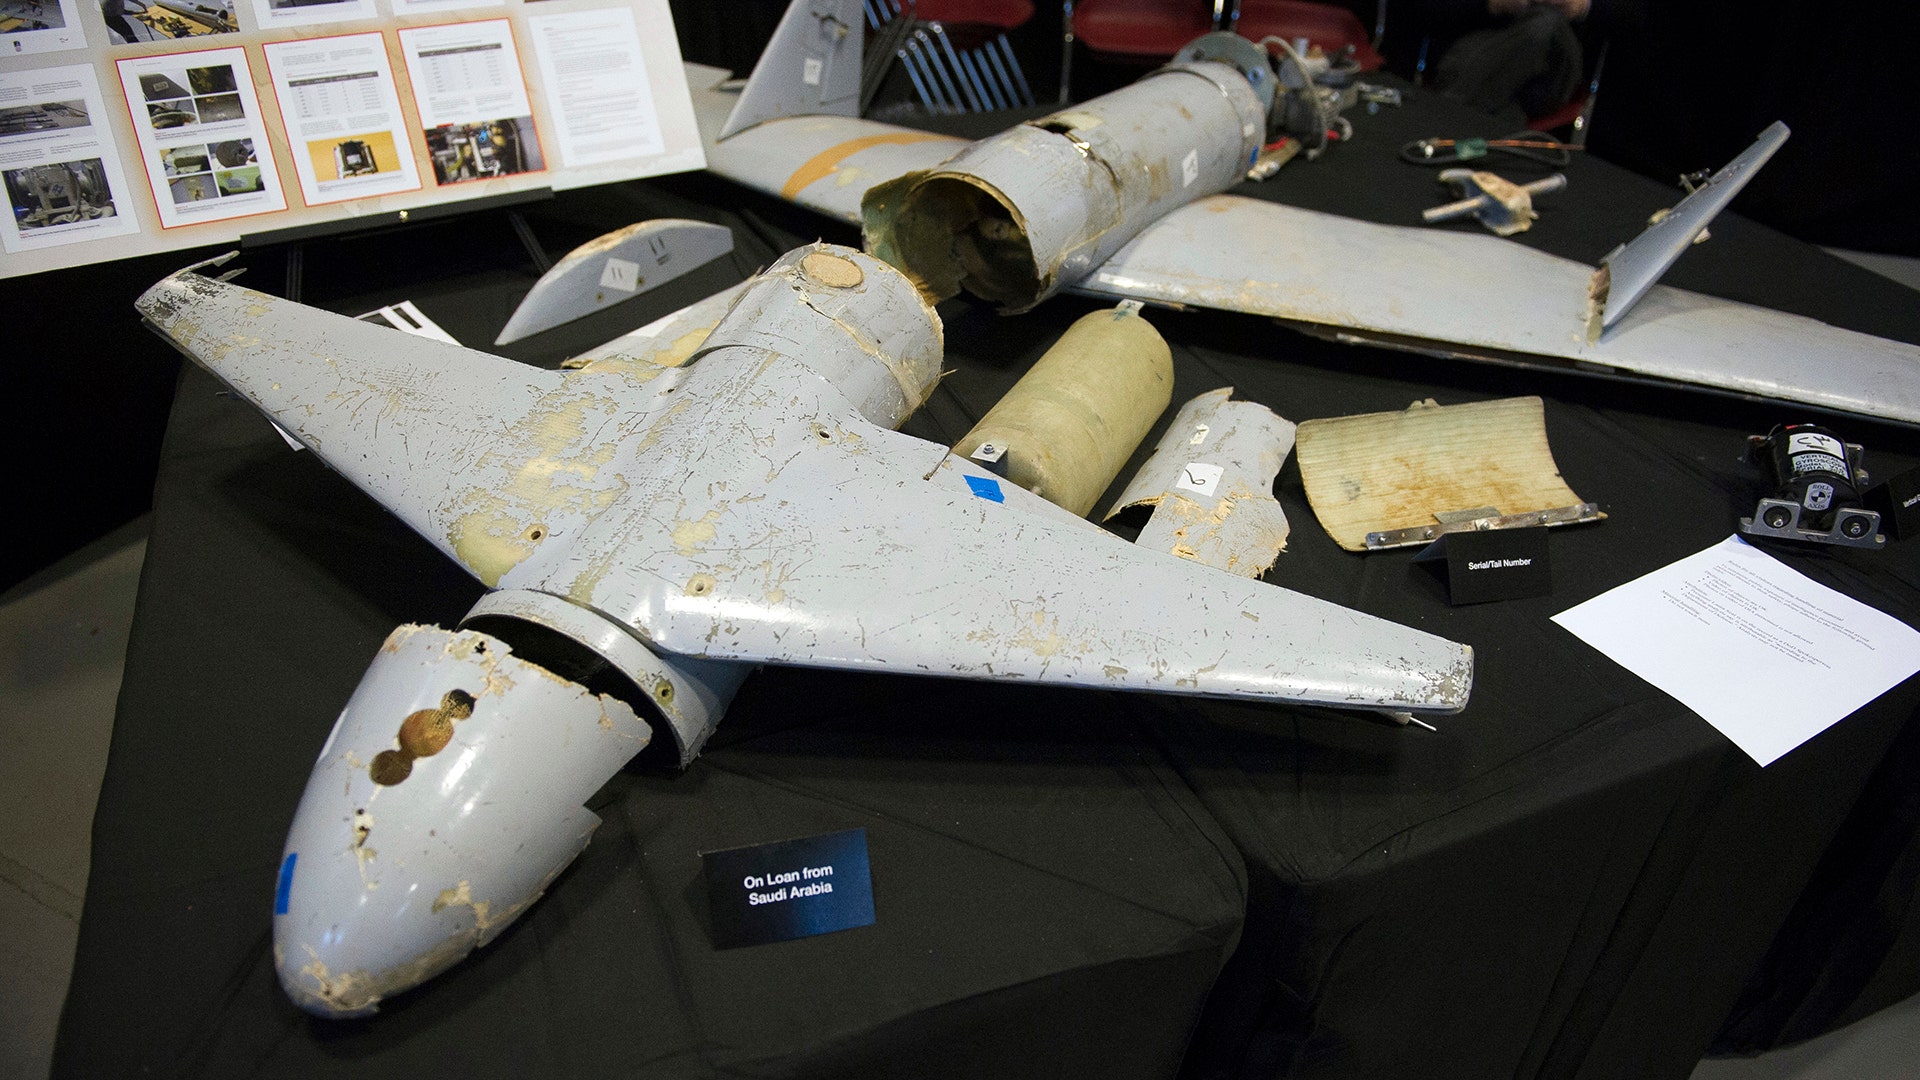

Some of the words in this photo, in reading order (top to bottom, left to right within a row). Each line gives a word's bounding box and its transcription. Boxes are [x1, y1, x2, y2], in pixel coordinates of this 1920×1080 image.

[1468, 560, 1502, 570] Serial/Tail
[1503, 558, 1532, 567] Number
[744, 876, 764, 889] On
[767, 870, 800, 886] Loan
[803, 865, 833, 879] from
[749, 889, 787, 906] Saudi
[790, 882, 833, 899] Arabia
